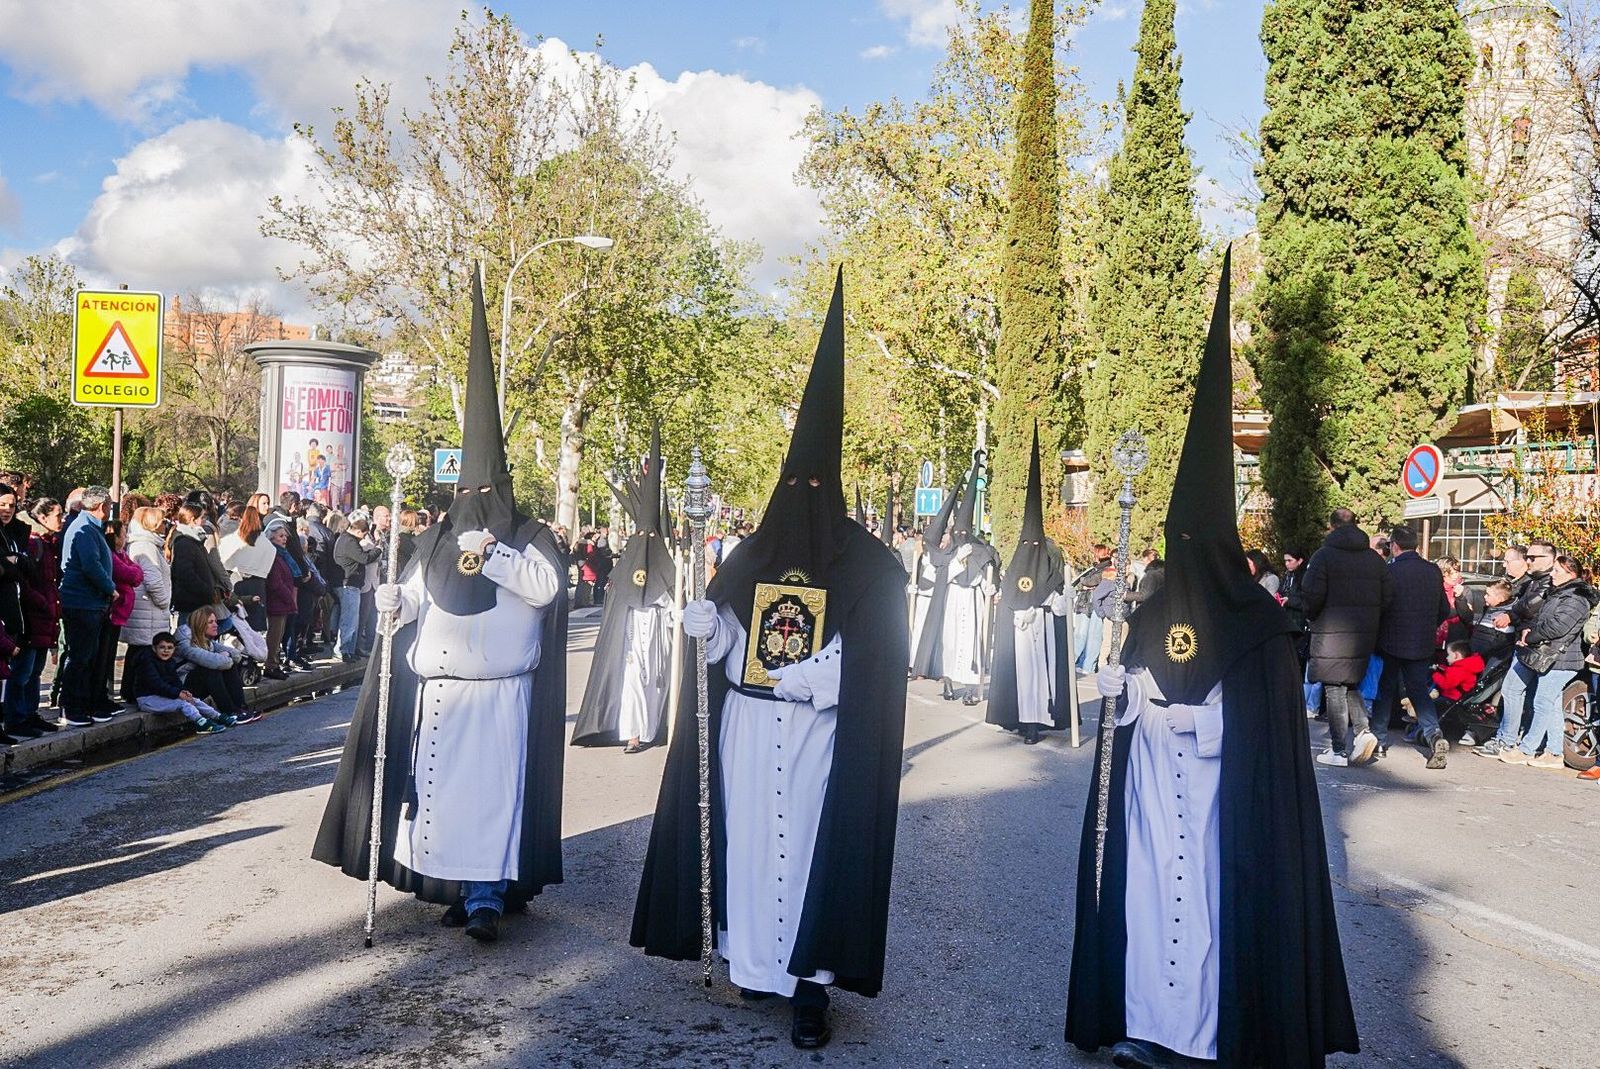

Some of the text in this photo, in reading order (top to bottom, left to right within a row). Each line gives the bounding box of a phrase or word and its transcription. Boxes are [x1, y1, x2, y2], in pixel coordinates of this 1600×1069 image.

[81, 299, 156, 312] ATENCIÓN
[82, 384, 150, 396] COLEGIO
[284, 386, 354, 412] LA FAMILIA
[283, 400, 353, 434] BENETON
